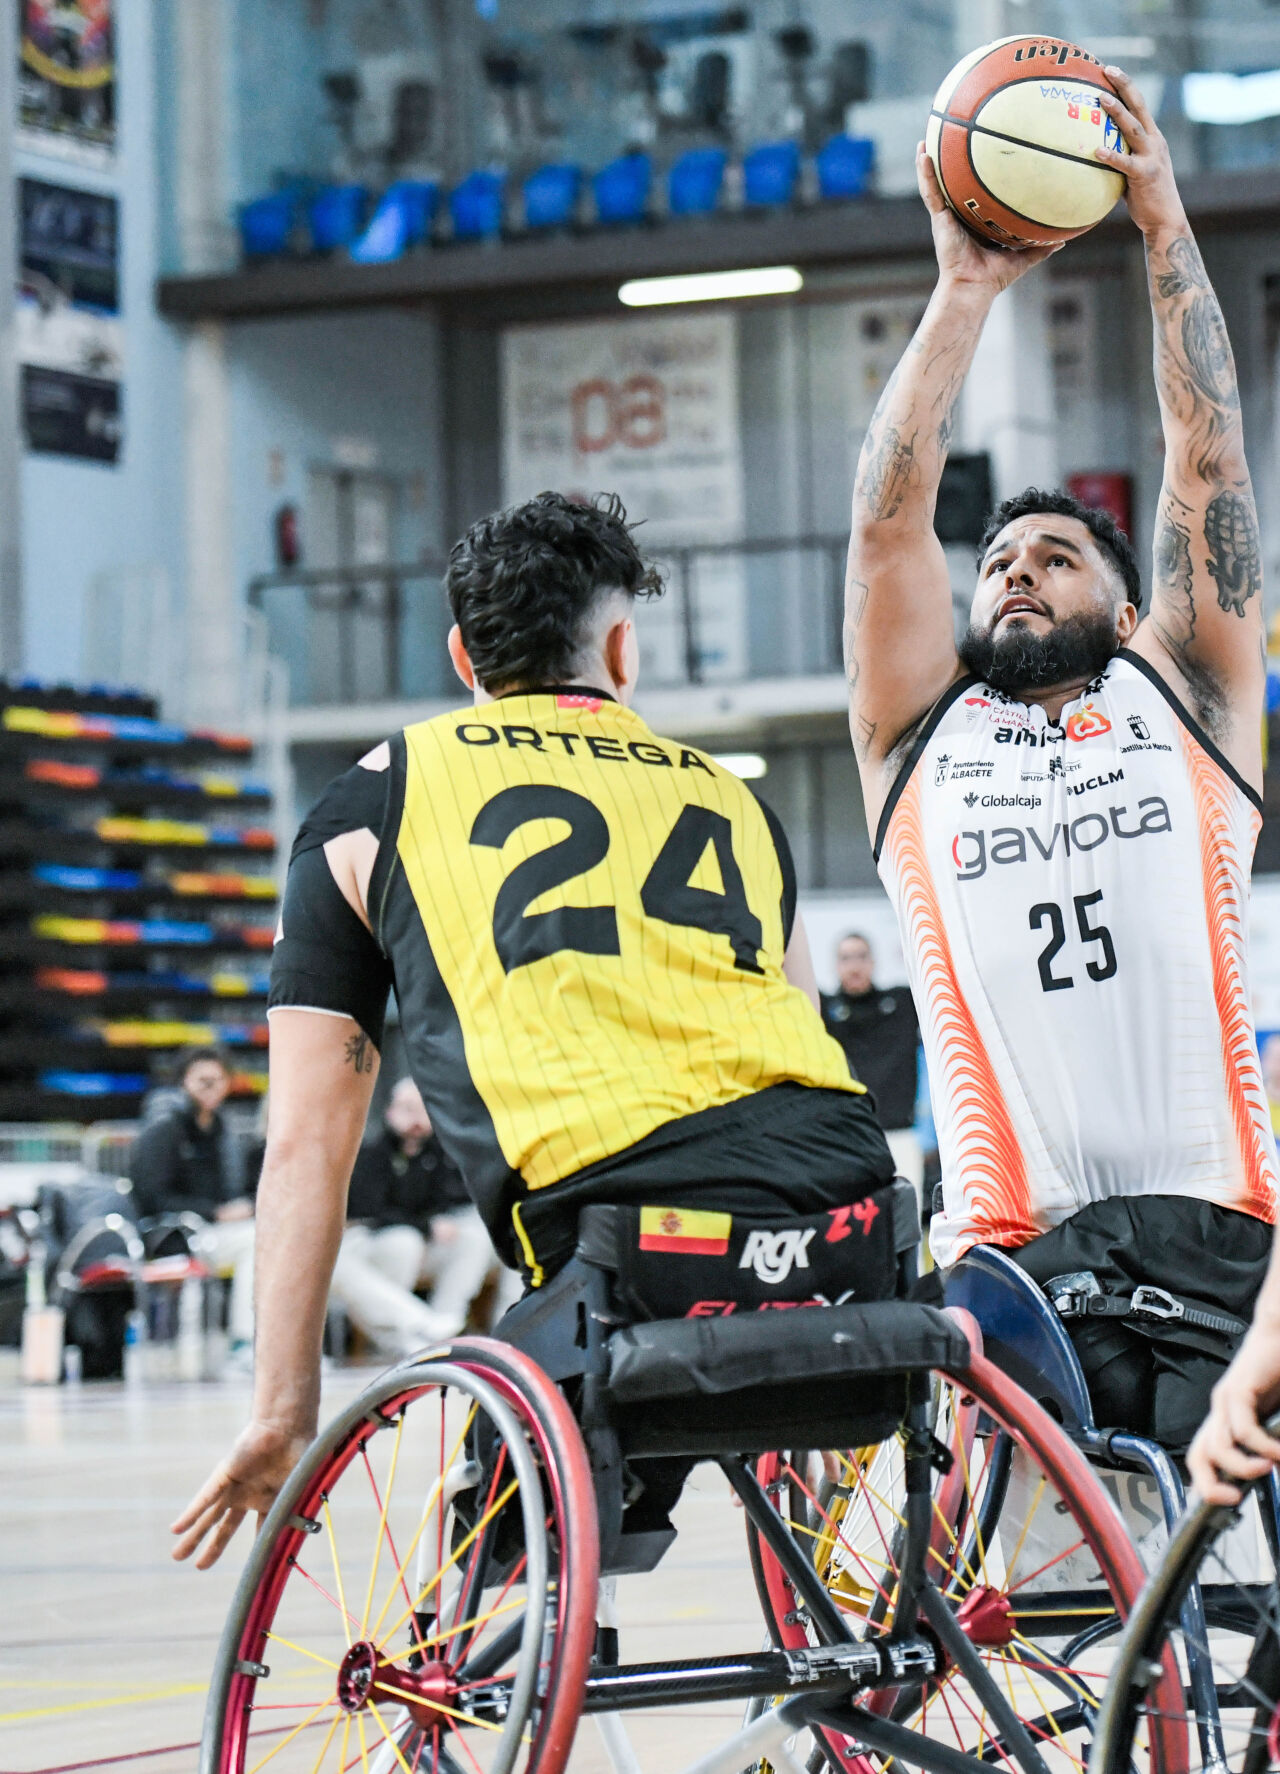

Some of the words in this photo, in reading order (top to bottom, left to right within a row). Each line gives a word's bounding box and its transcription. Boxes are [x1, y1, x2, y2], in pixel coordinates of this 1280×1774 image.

[1014, 45, 1102, 66] aden
[455, 723, 717, 778] ORTEGA
[951, 769, 993, 780] ALBACETE
[1073, 768, 1125, 796] UCLM
[981, 794, 1042, 810] Globalcaja
[952, 796, 1173, 881] gaviota
[469, 784, 766, 977] 24
[1028, 889, 1118, 992] 25
